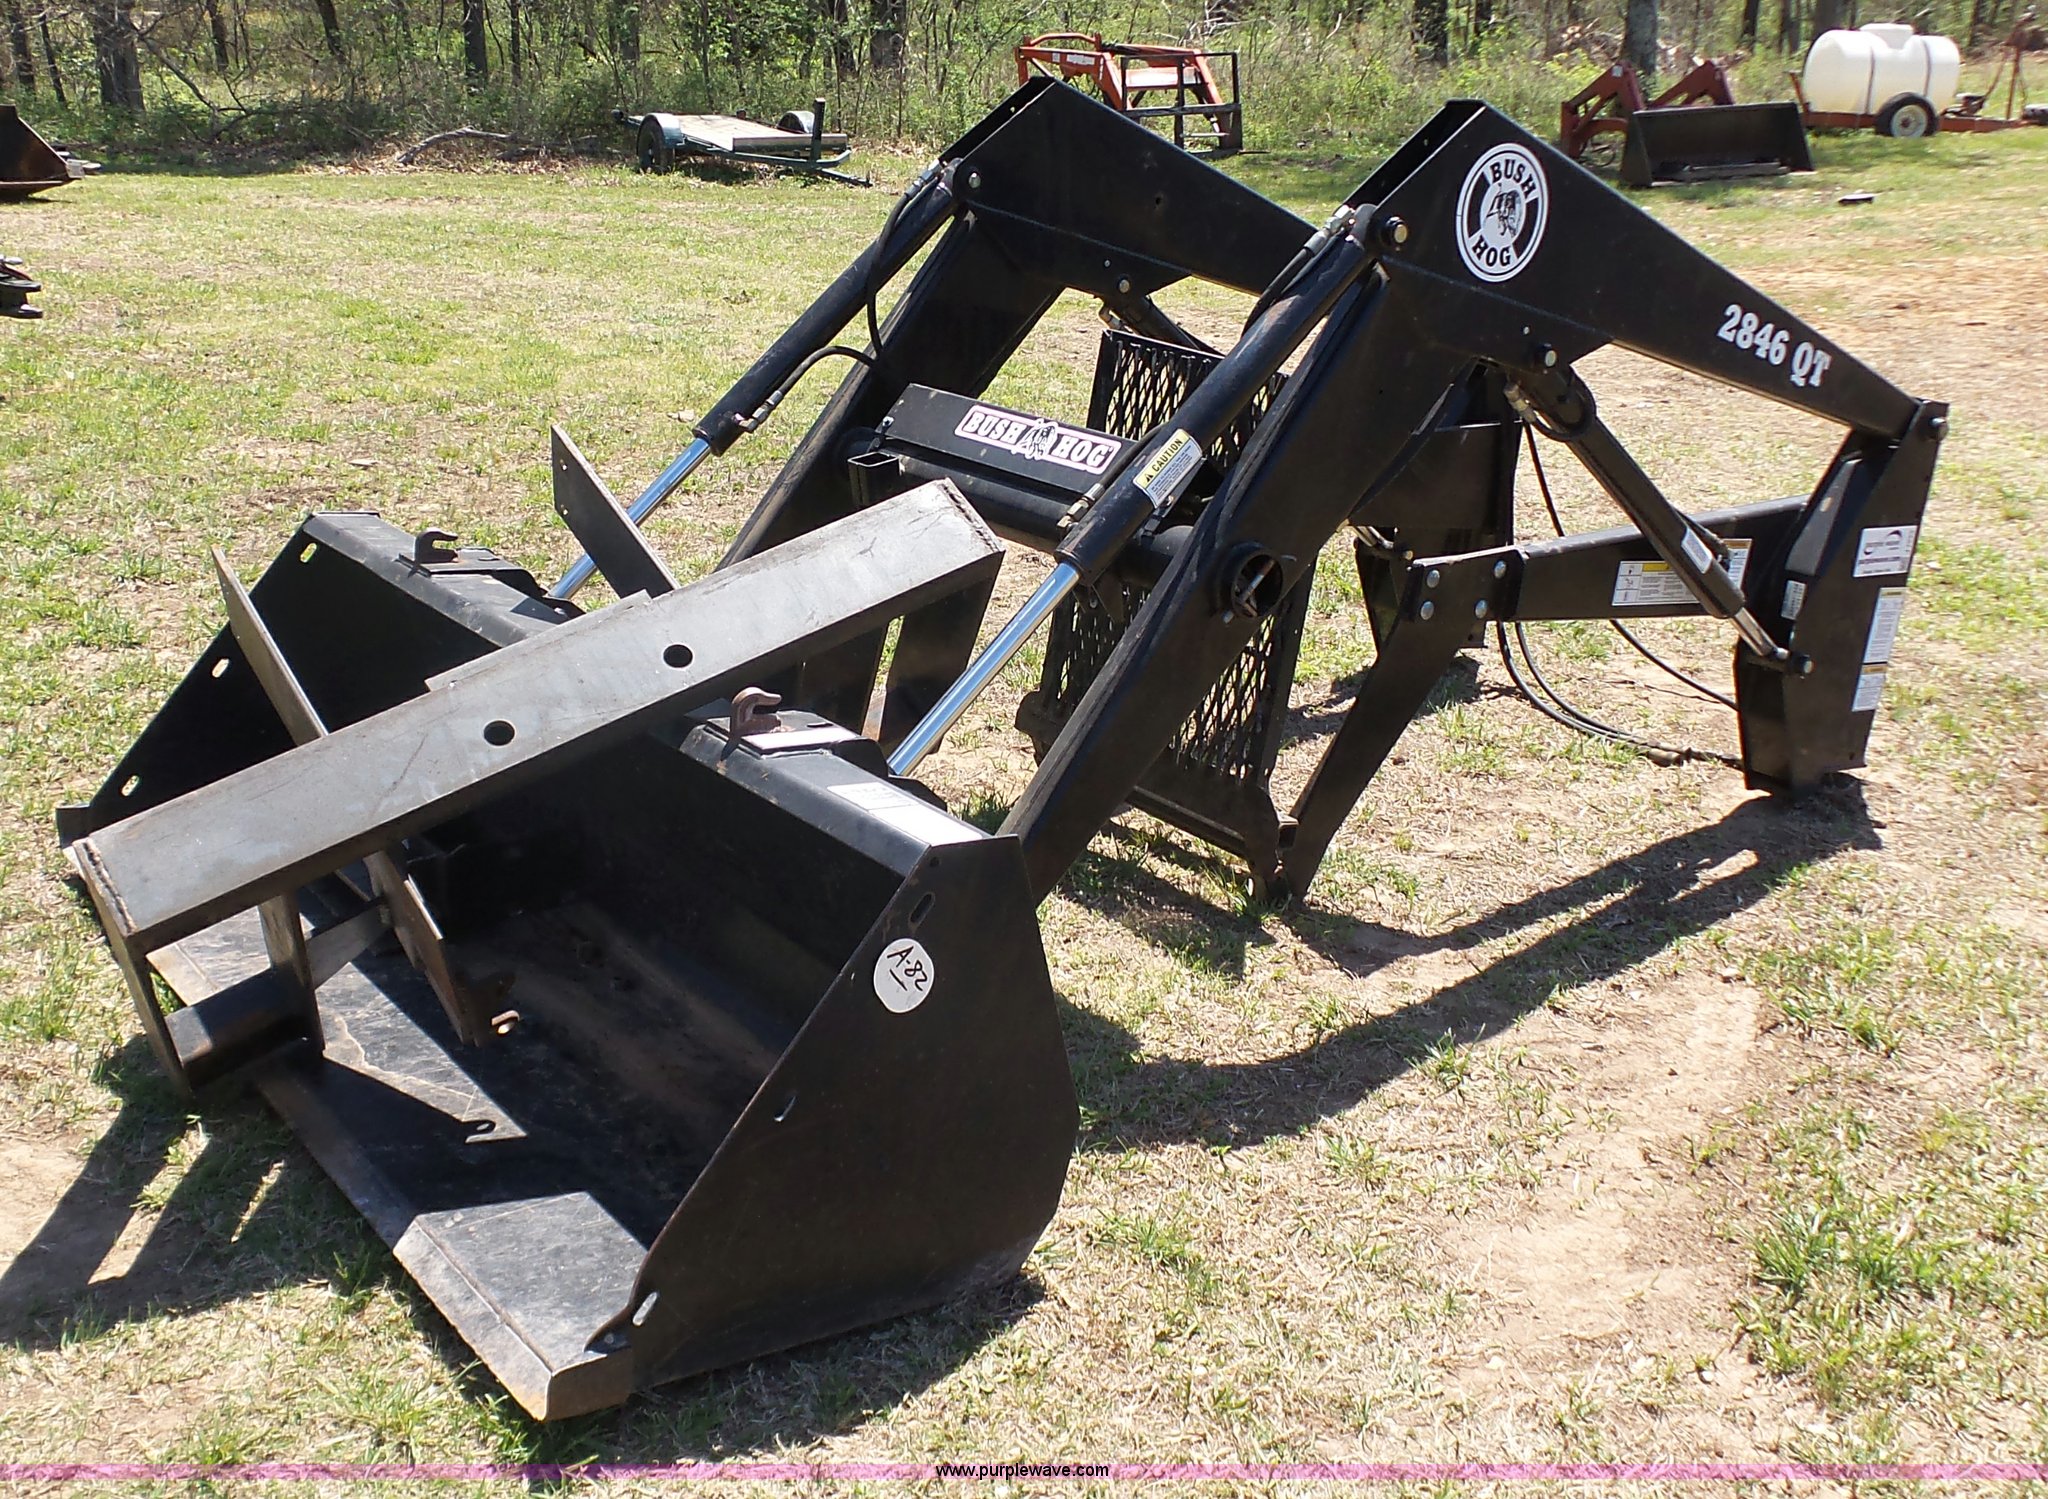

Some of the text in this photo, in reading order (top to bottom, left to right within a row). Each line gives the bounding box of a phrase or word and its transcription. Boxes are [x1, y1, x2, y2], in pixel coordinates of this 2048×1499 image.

[1490, 159, 1536, 199] BUSH
[1472, 233, 1511, 267] HOG
[1717, 304, 1832, 387] 2846 QT
[963, 413, 1111, 467] BUSH HOG
[1151, 438, 1183, 472] CAUTION
[887, 945, 928, 992] A-82
